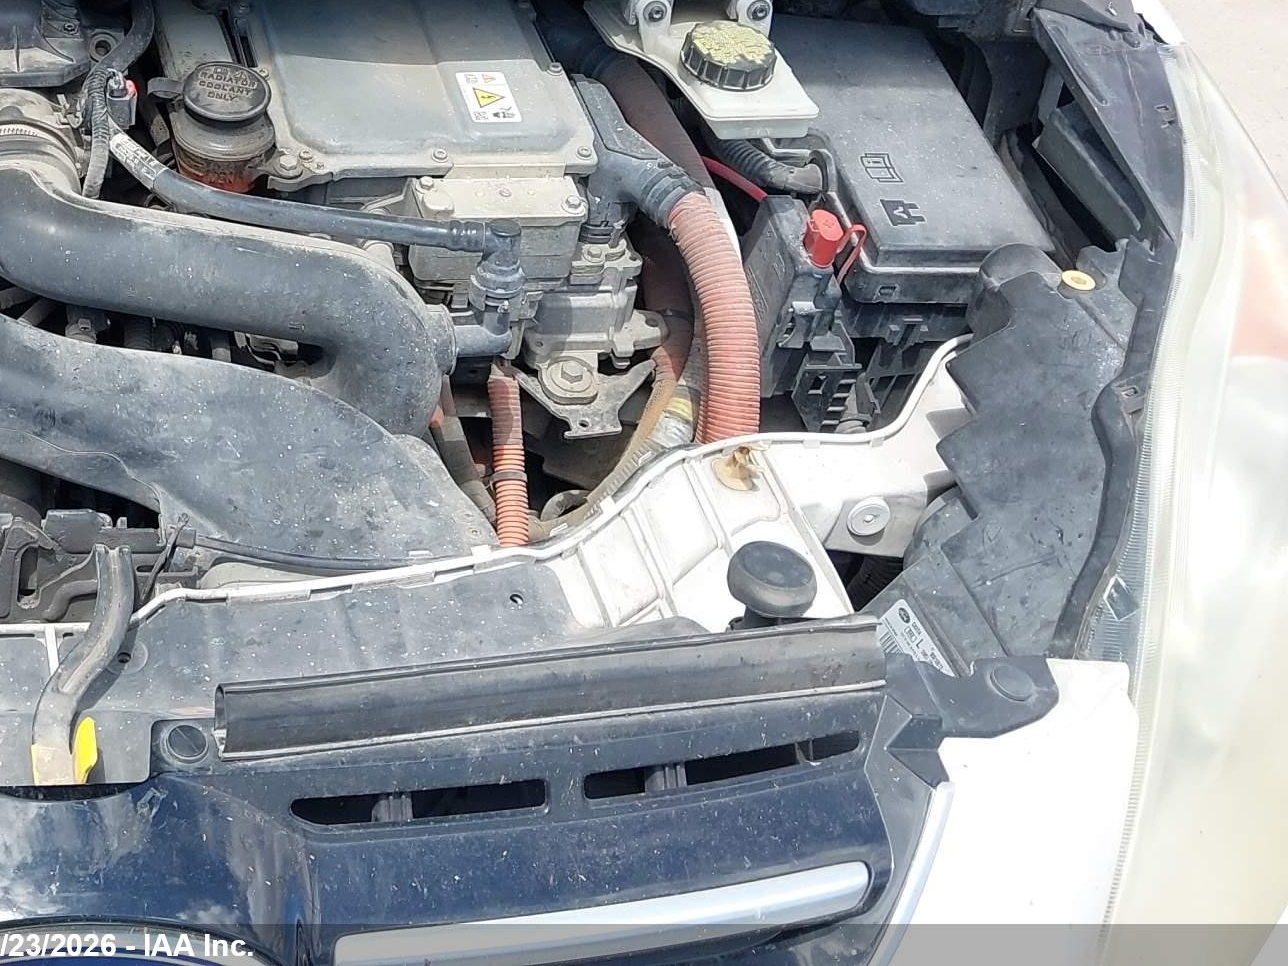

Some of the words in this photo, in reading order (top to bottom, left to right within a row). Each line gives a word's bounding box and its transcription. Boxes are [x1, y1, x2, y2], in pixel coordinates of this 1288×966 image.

[199, 71, 258, 88] RADIATOR
[198, 80, 254, 96] COOLANT
[206, 91, 239, 102] ONLY
